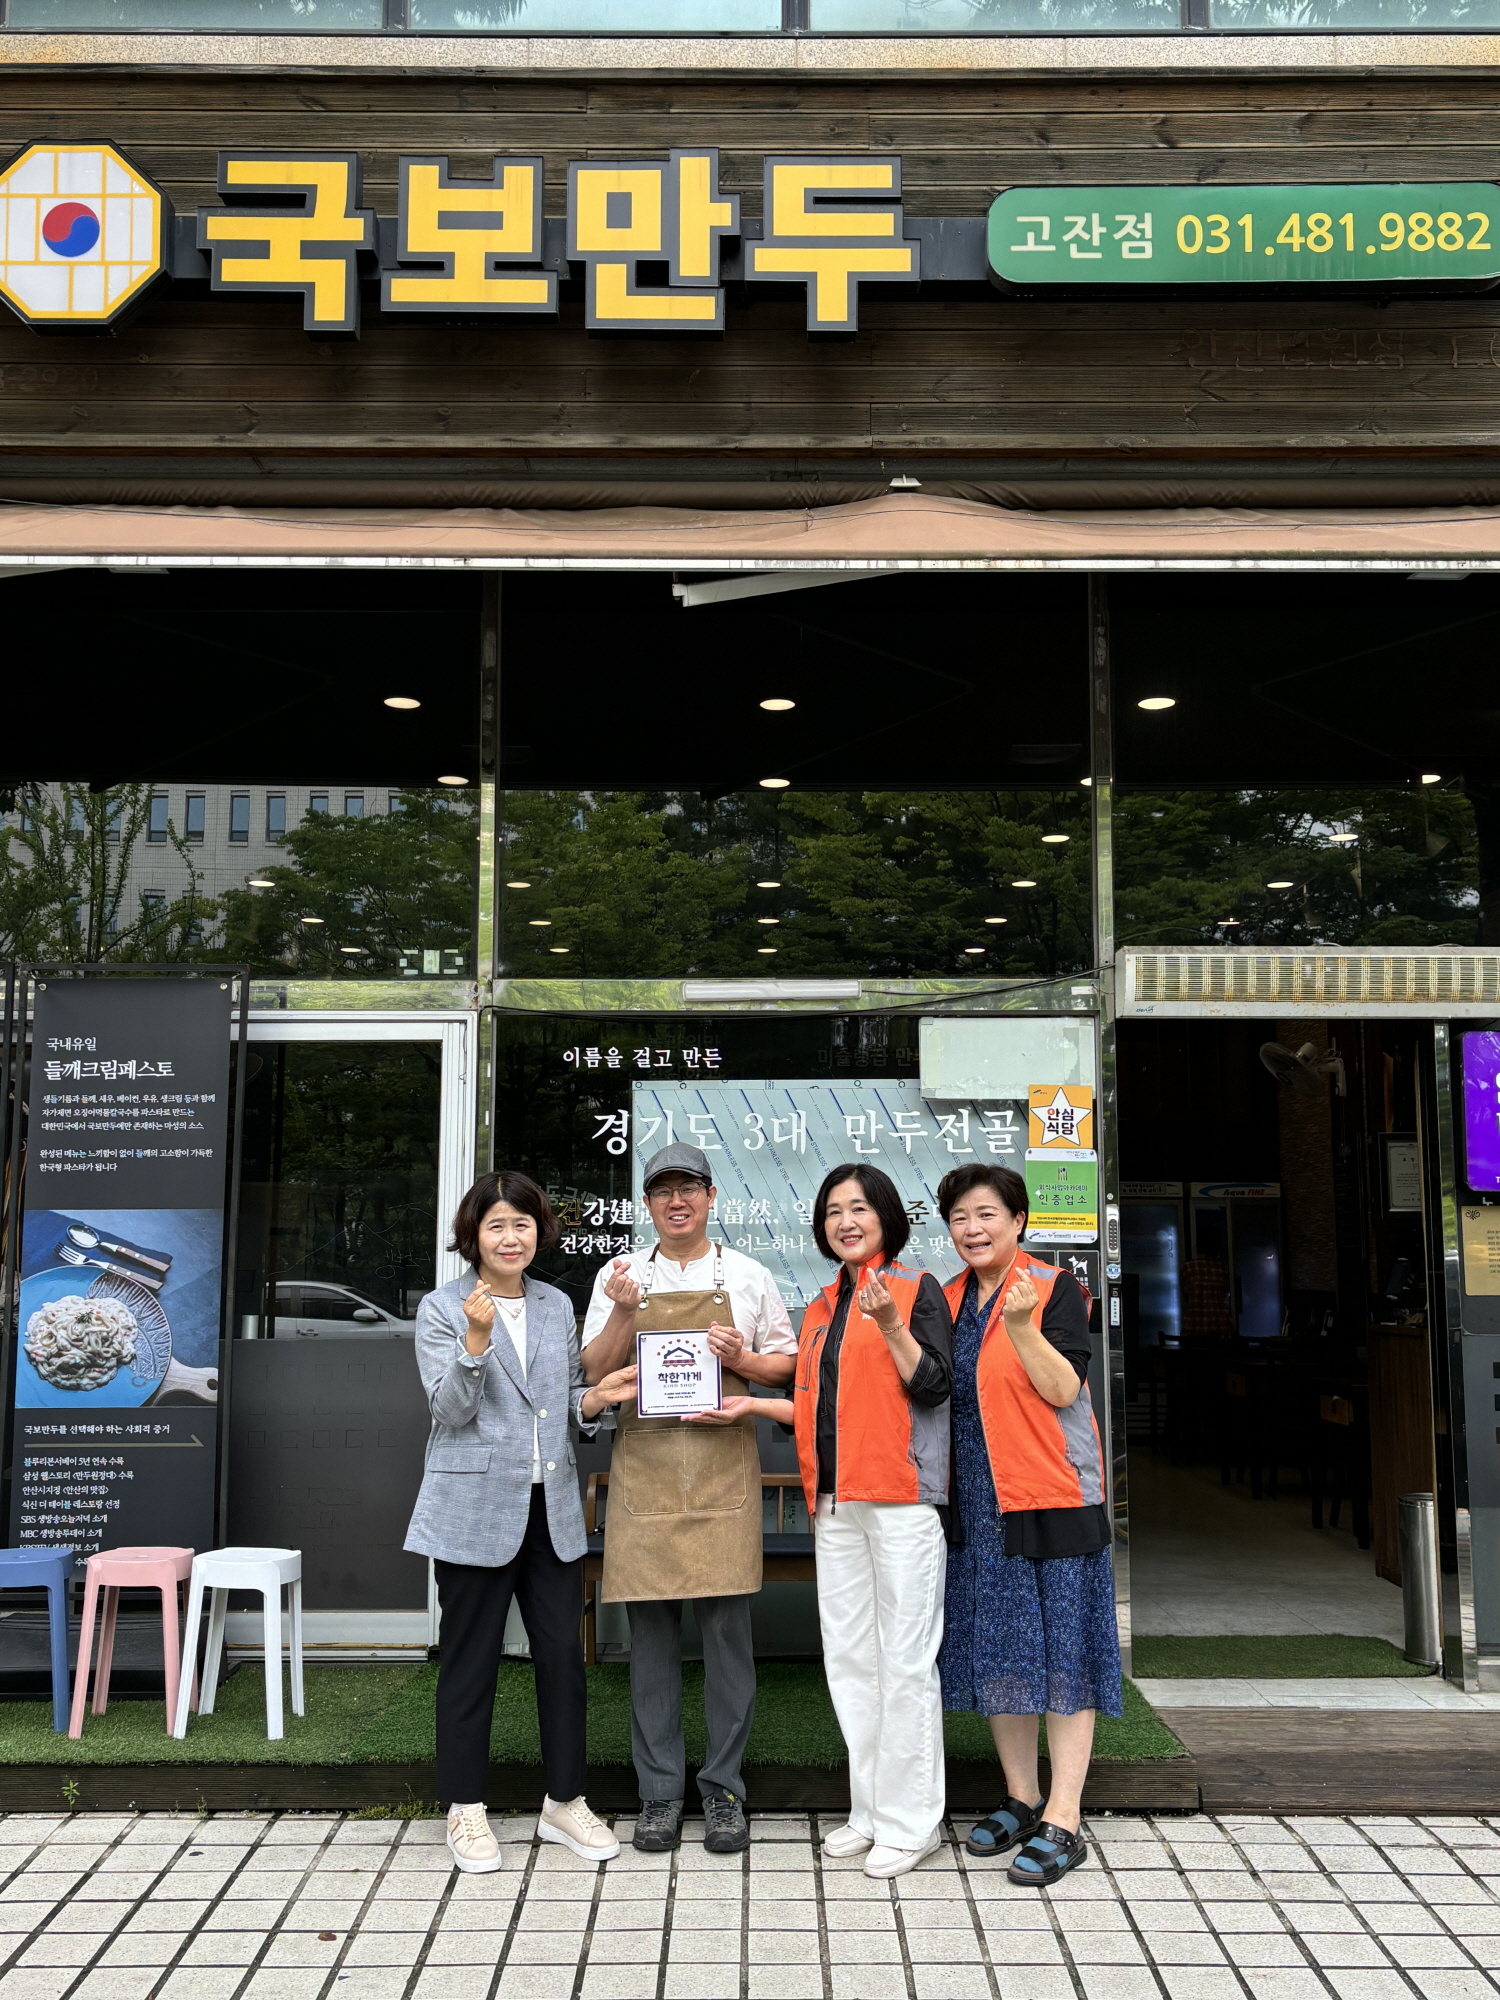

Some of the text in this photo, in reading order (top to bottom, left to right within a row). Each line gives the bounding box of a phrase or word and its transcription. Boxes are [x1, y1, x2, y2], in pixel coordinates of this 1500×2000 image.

[205, 155, 913, 323] 국보만두
[1010, 211, 1492, 259] 고잔점 031.481.9882
[46, 1036, 97, 1052] 국내유일
[562, 1046, 723, 1069] 이름을 걸고 만든
[43, 1059, 175, 1080] 들깨크림페스토
[160, 1093, 183, 1104] 생크림
[201, 1093, 216, 1104] 함께
[41, 1107, 72, 1117] 자가제면
[141, 1107, 171, 1117] 파스타로
[172, 1107, 195, 1117] 만드는
[1047, 1108, 1074, 1121] 안심
[41, 1121, 86, 1131] 대한민국에서
[87, 1121, 132, 1131] 국보만두에만
[133, 1121, 163, 1131] 존재하는
[164, 1121, 187, 1131] 마성의
[1046, 1122, 1075, 1136] 식당
[591, 1109, 723, 1156] 경기도
[743, 1109, 807, 1155] 3대
[842, 1108, 1021, 1155] 만두전골
[39, 1148, 63, 1159] 완성된
[64, 1148, 87, 1159] 메뉴는
[87, 1148, 118, 1159] 느끼함이
[119, 1148, 134, 1159] 없이
[159, 1148, 189, 1159] 고소함이
[190, 1148, 214, 1159] 가득한
[39, 1162, 118, 1172] 한국형 파스타가 됩니다
[1038, 1193, 1087, 1206] 인증업소
[736, 1233, 808, 1255] 어느하나
[657, 1371, 702, 1384] 착한가게
[23, 1424, 170, 1435] 국보만두를 선택해야 하는 사회적 증거
[23, 1456, 124, 1467] 블루리본서베이 5년 연속 수록
[22, 1471, 39, 1481] 삼성
[118, 1471, 134, 1481] 수록
[22, 1485, 61, 1495] 안산시지정
[21, 1499, 38, 1510] 식신
[72, 1499, 103, 1510] 레스토랑
[104, 1499, 120, 1510] 선정
[20, 1514, 37, 1524] SBS
[92, 1514, 108, 1524] 소개
[20, 1528, 103, 1538] MBC 생방송투데이 소개
[84, 1542, 100, 1552] 소개
